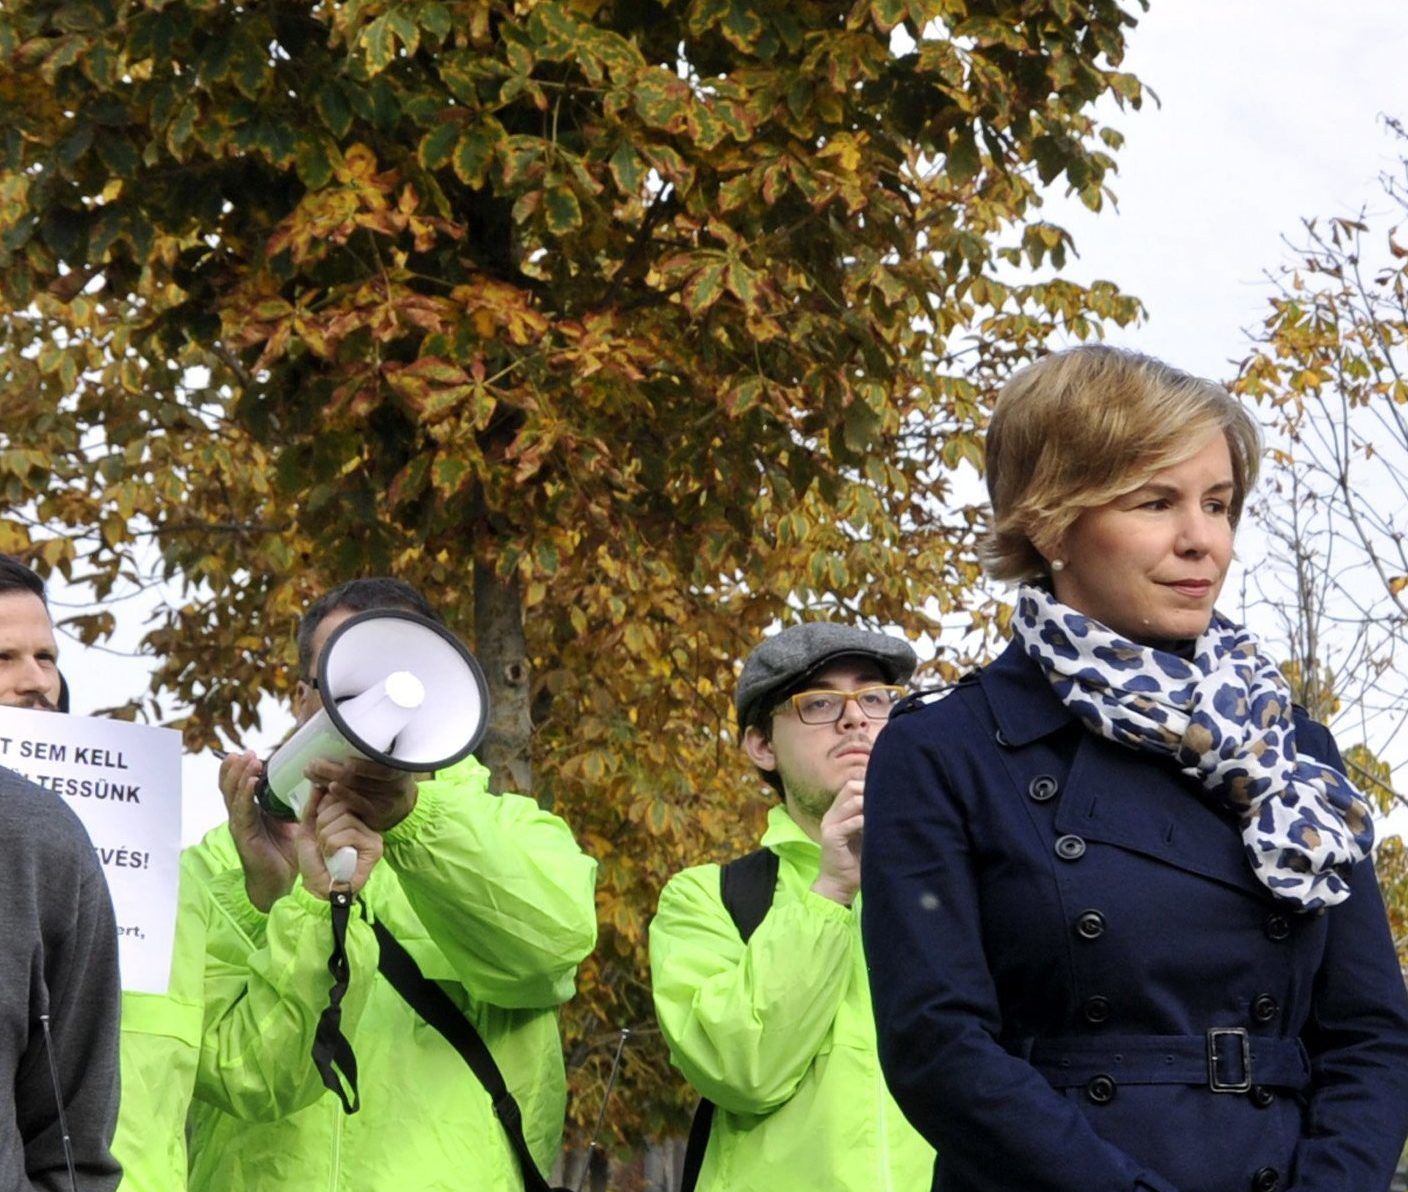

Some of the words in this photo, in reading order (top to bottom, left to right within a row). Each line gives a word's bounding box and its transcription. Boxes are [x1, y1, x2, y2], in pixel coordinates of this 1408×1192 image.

[20, 740, 67, 762] SEM
[74, 747, 129, 769] KELL
[93, 846, 149, 869] VÉS!
